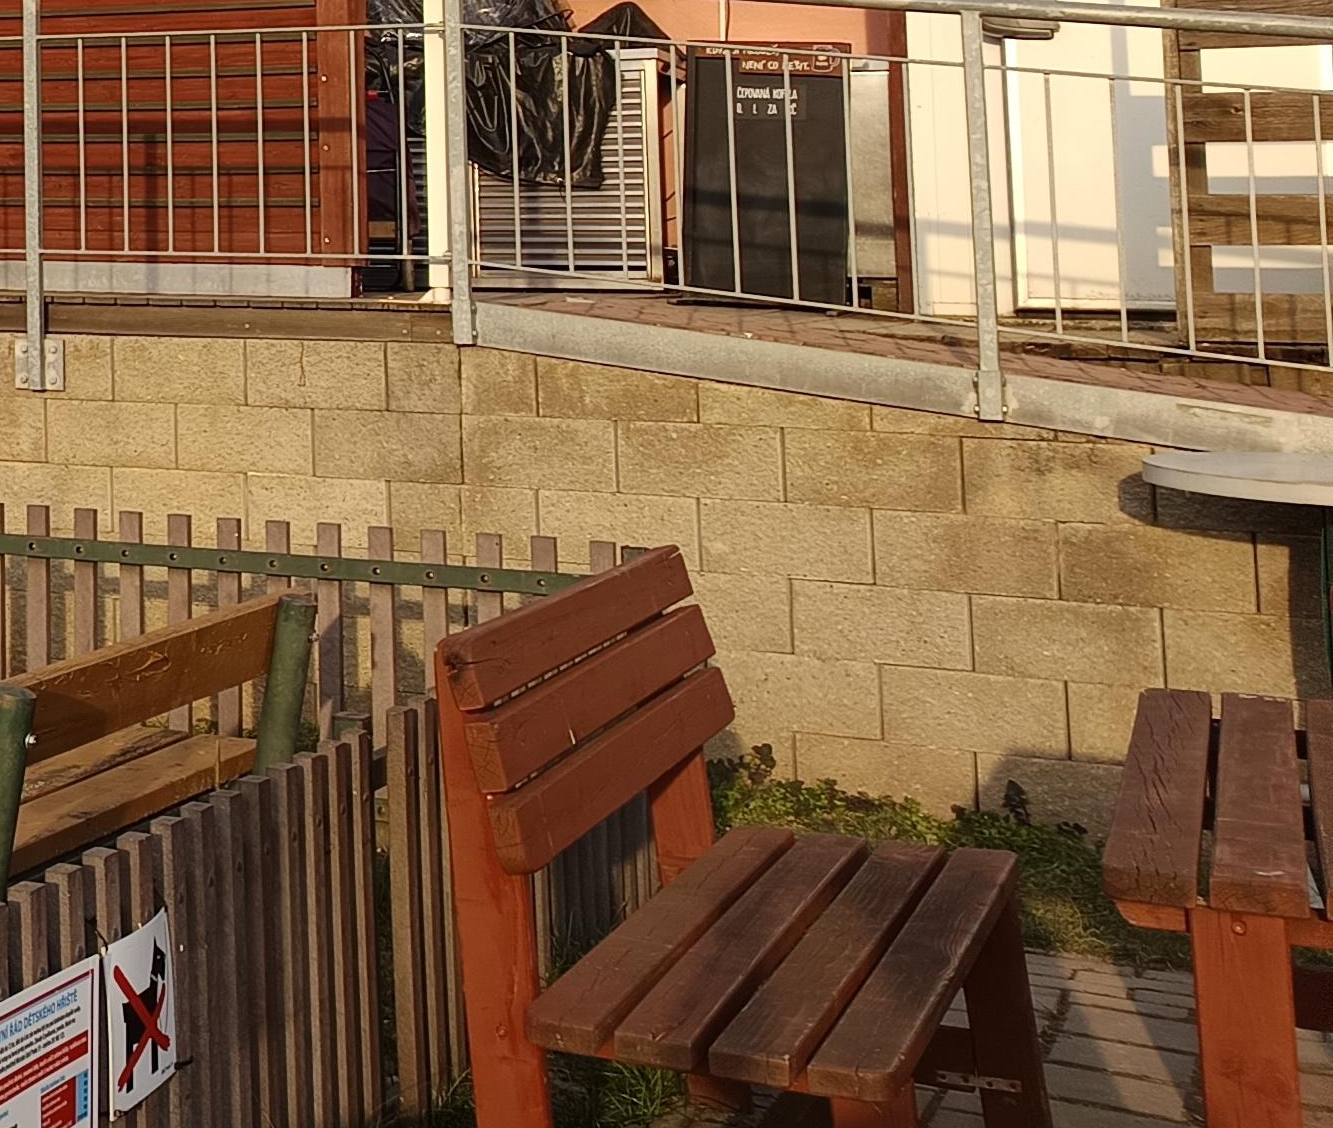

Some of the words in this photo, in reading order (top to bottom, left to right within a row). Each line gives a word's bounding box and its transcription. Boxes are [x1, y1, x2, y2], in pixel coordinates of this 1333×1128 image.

[768, 60, 779, 71] CO
[782, 59, 811, 71] EŠIT.
[772, 87, 798, 101] KOFLA
[9, 1019, 23, 1037] ŘÁD
[23, 1002, 56, 1029] DĚTSKÉHO
[56, 988, 78, 1011] HŘIŠTĚ
